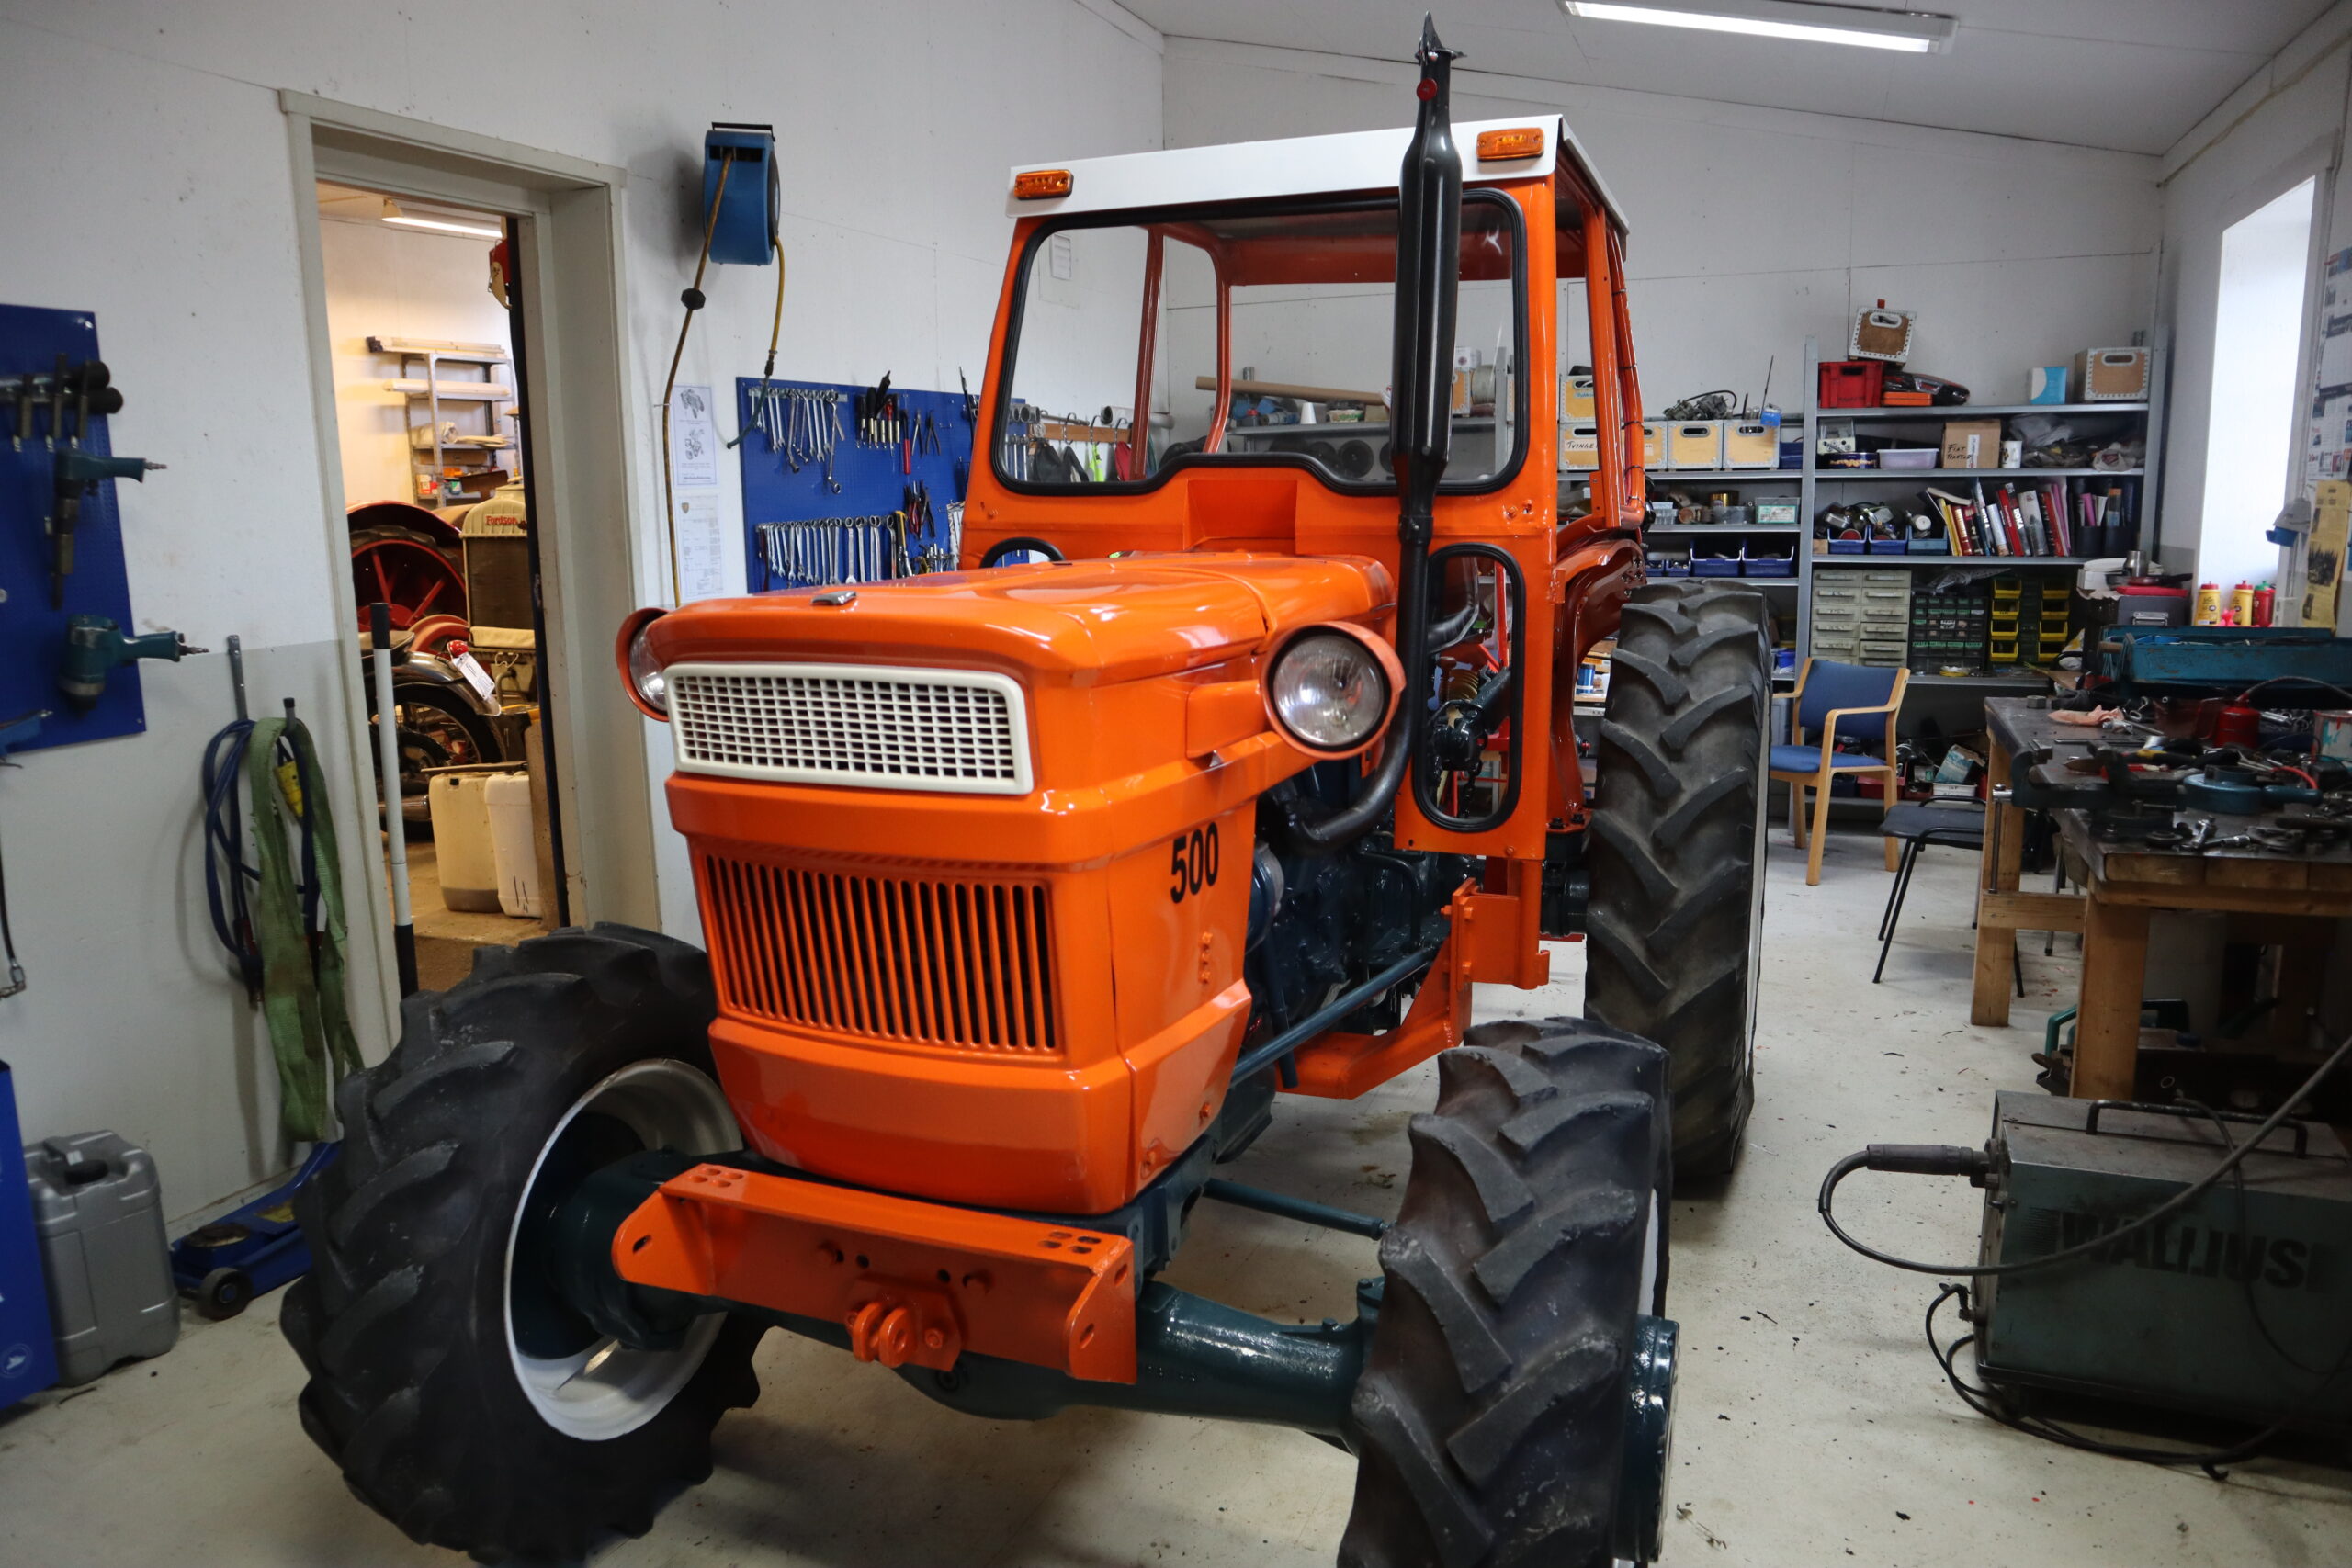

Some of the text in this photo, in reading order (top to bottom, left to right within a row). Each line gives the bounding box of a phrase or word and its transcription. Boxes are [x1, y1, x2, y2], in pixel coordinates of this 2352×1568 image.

[485, 516, 519, 525] Fordson
[1170, 821, 1219, 905] 500
[2061, 1211, 2308, 1291] WALLIUS
